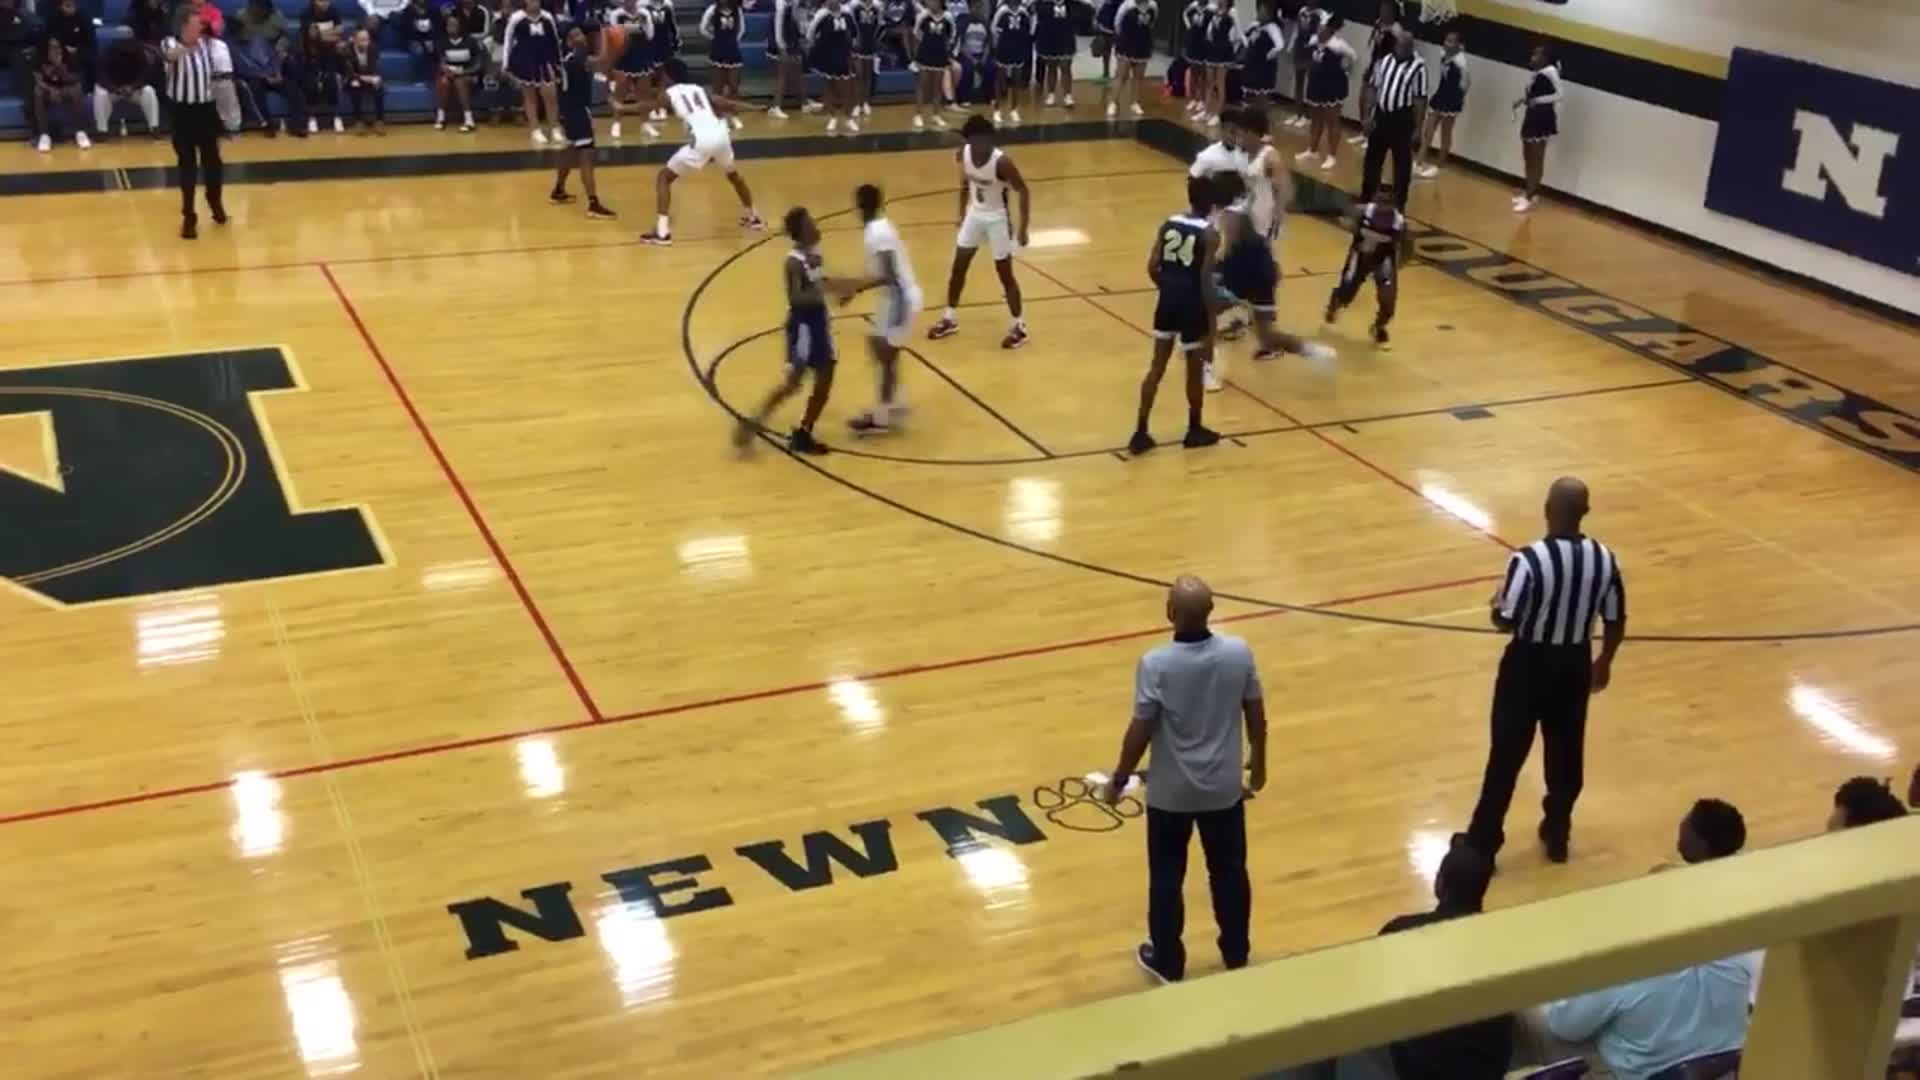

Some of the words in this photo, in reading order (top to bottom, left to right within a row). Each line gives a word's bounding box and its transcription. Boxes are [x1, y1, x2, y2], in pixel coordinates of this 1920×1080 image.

[680, 90, 706, 114] 14
[1781, 108, 1900, 220] N
[1163, 228, 1196, 267] 24
